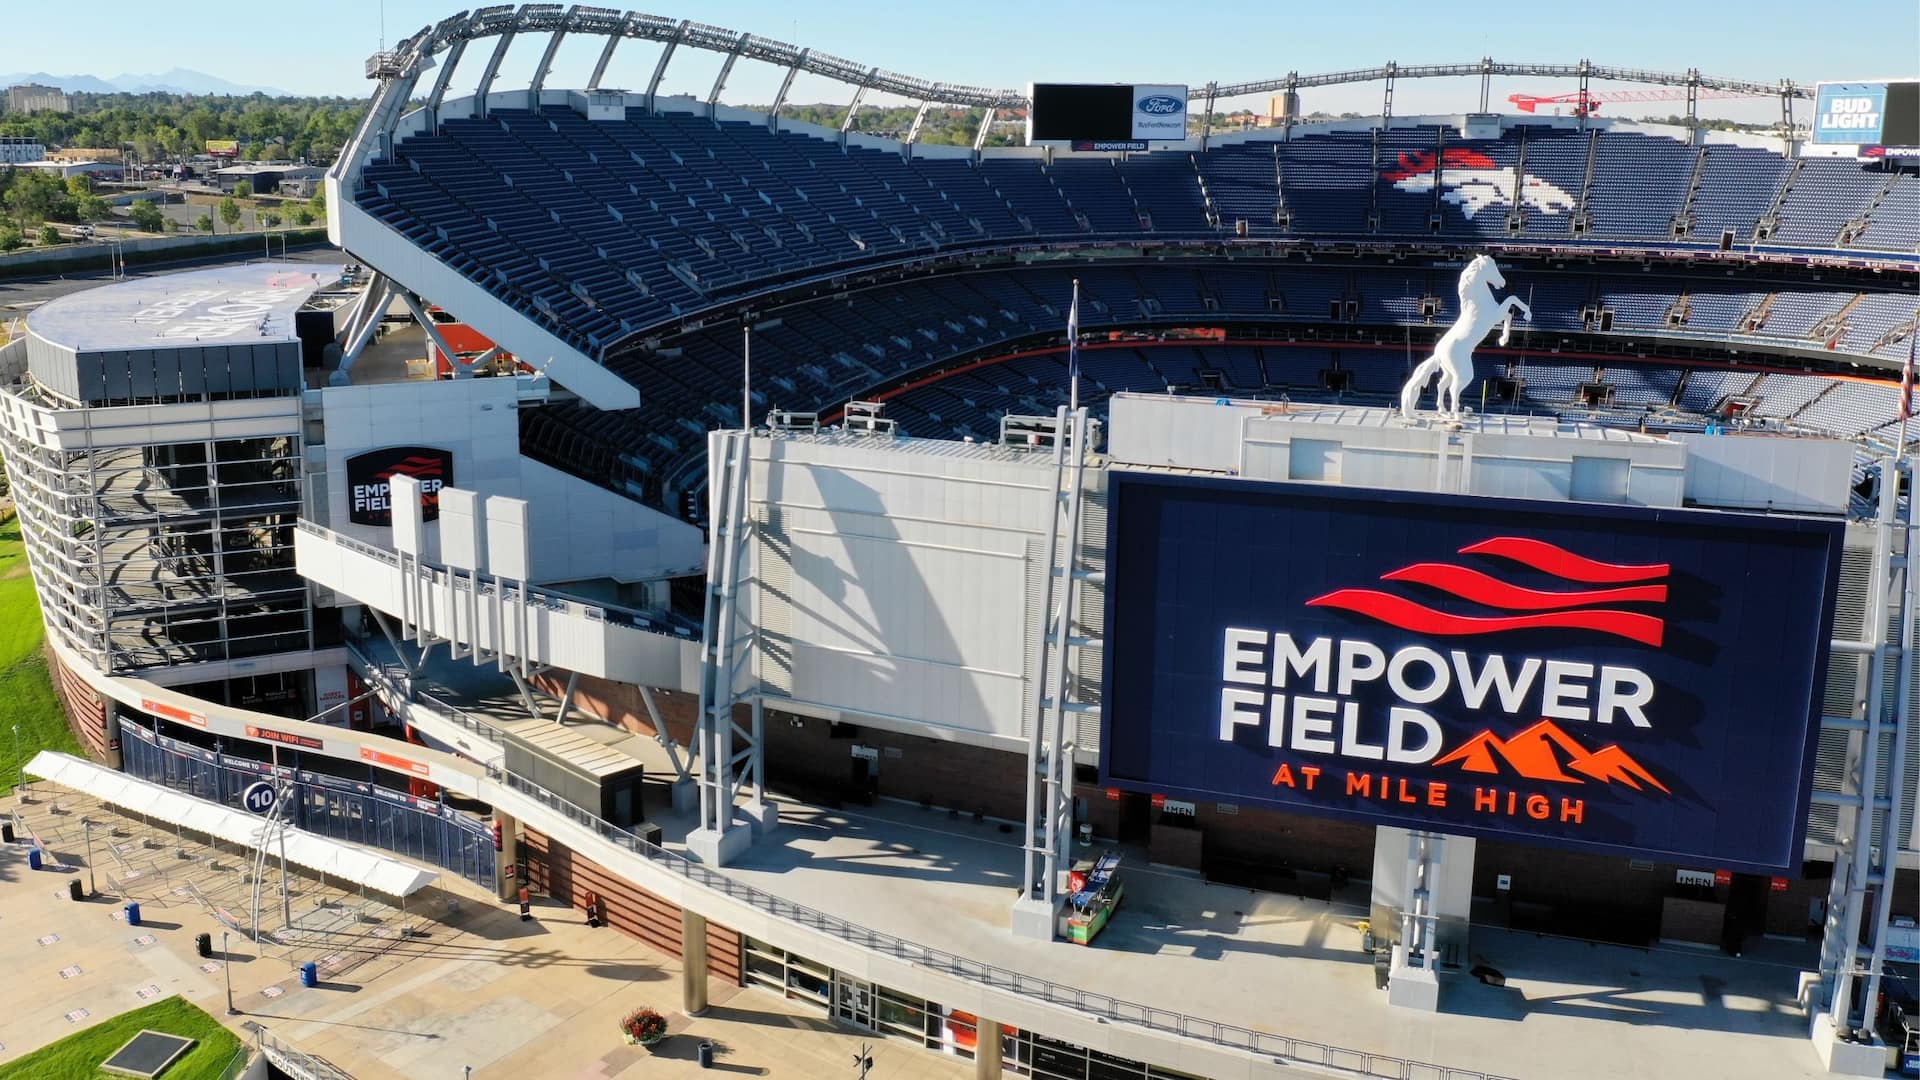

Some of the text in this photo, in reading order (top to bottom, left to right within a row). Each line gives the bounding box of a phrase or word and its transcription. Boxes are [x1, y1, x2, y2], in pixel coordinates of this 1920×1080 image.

[1146, 98, 1177, 113] Ford
[1830, 98, 1873, 114] BUD
[1821, 113, 1879, 129] LIGHT
[354, 479, 443, 498] EMPER
[355, 496, 392, 512] FIEL
[1222, 626, 1655, 729] EMPOWER
[1219, 687, 1445, 765] FIELD
[261, 730, 280, 740] JOIN
[280, 733, 299, 744] WIFI
[223, 758, 251, 769] WELCOME
[250, 789, 274, 809] 10
[1271, 763, 1585, 825] AT MILE HIGH
[1171, 806, 1193, 817] MEN
[1686, 876, 1711, 887] MEN
